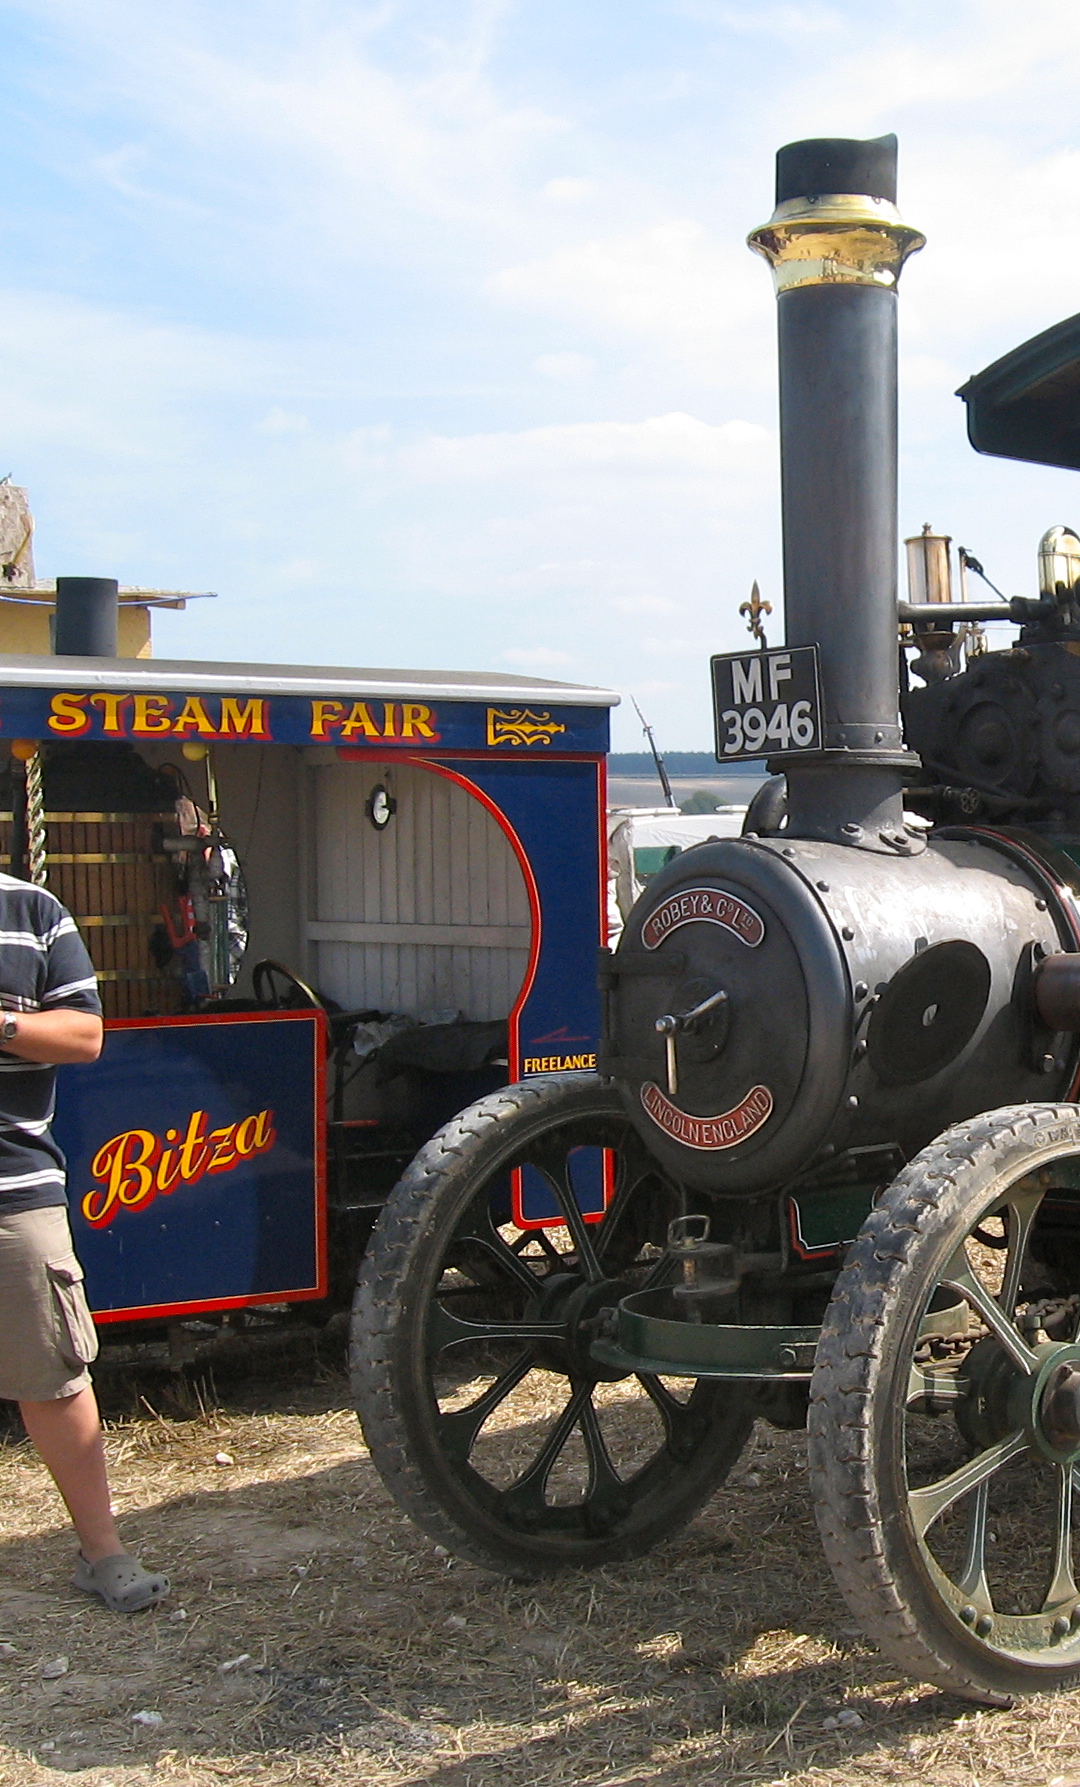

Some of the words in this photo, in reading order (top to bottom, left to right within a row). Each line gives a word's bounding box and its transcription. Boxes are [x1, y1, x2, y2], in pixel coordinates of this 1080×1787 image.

[48, 692, 272, 740] STEAM
[309, 700, 440, 742] FAIR
[721, 700, 814, 754] 3946
[651, 895, 699, 936] ROBEY
[524, 1053, 597, 1073] FREELANCE
[644, 1086, 699, 1142] LINCOLN
[702, 1091, 769, 1144] ENGLAND
[81, 1110, 273, 1226] Bitza
